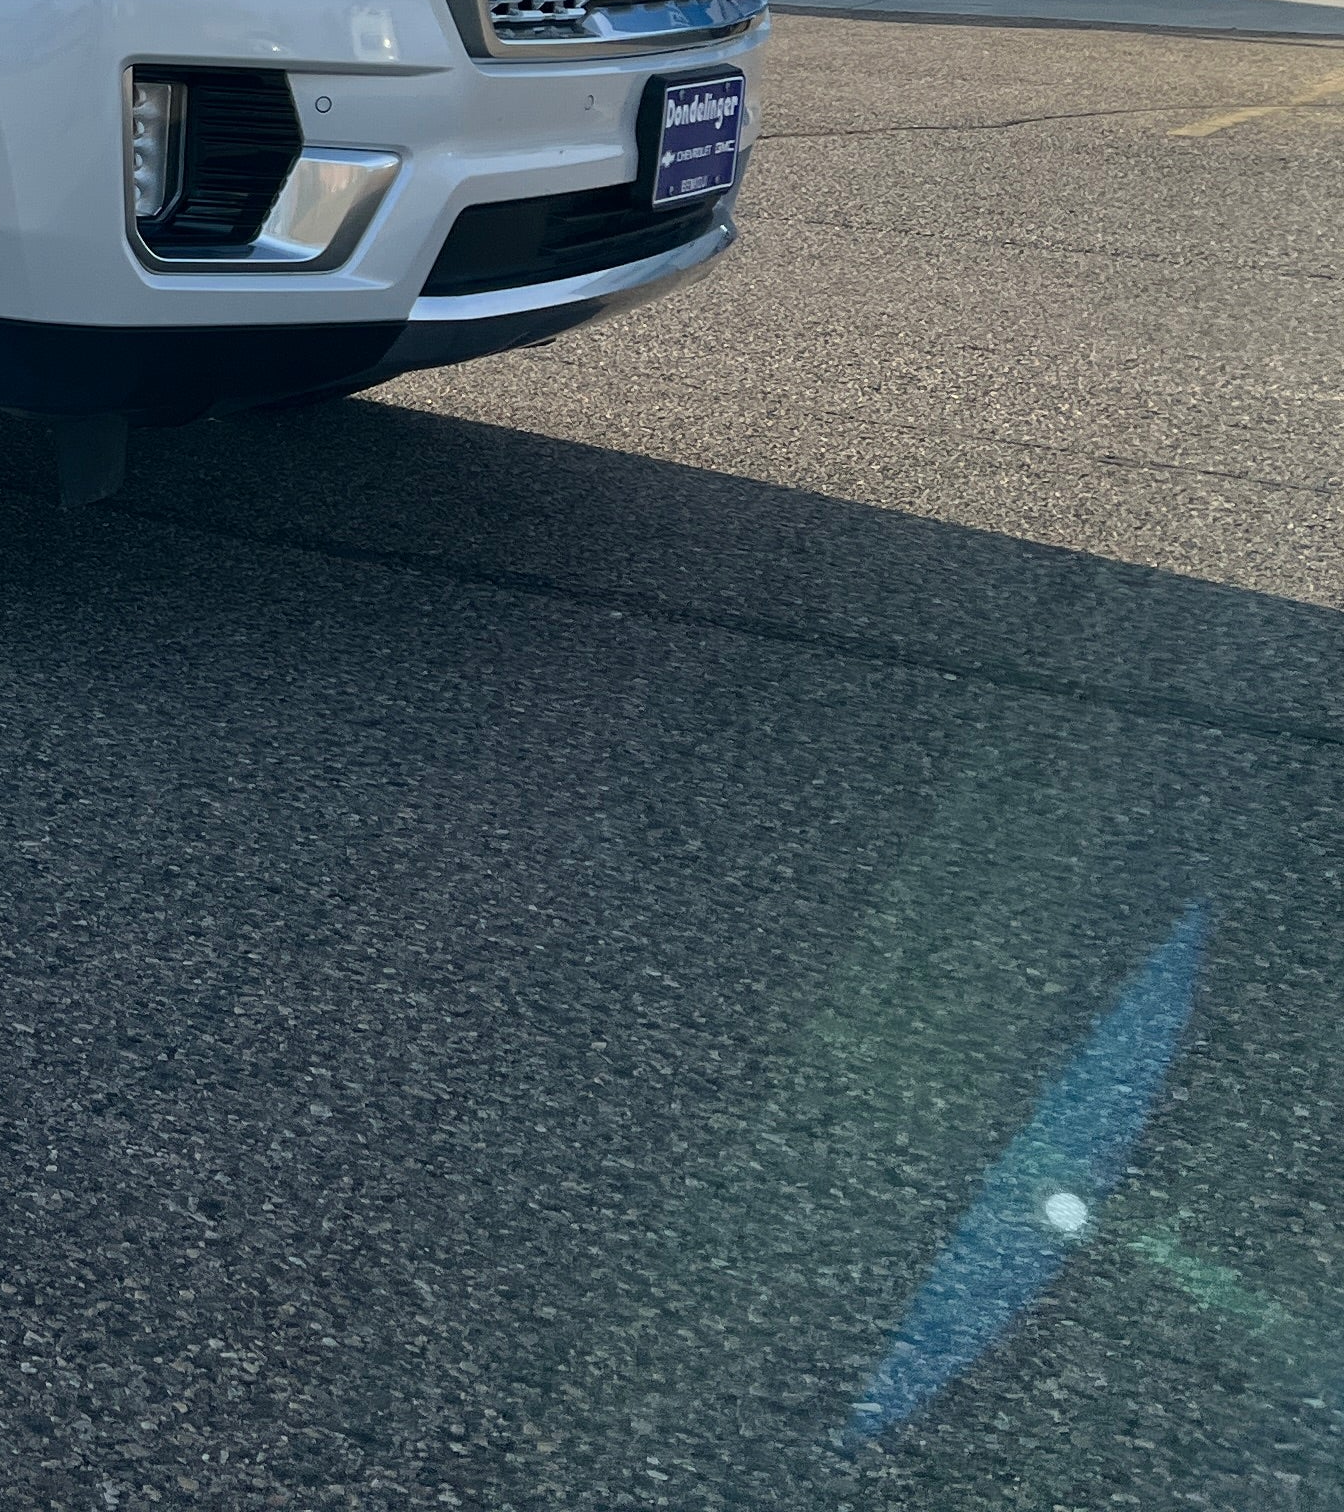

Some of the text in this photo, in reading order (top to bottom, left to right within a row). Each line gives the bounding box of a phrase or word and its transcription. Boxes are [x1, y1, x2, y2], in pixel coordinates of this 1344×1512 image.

[665, 92, 738, 130] Dondelinger
[676, 139, 736, 162] CHEVROLET GMC
